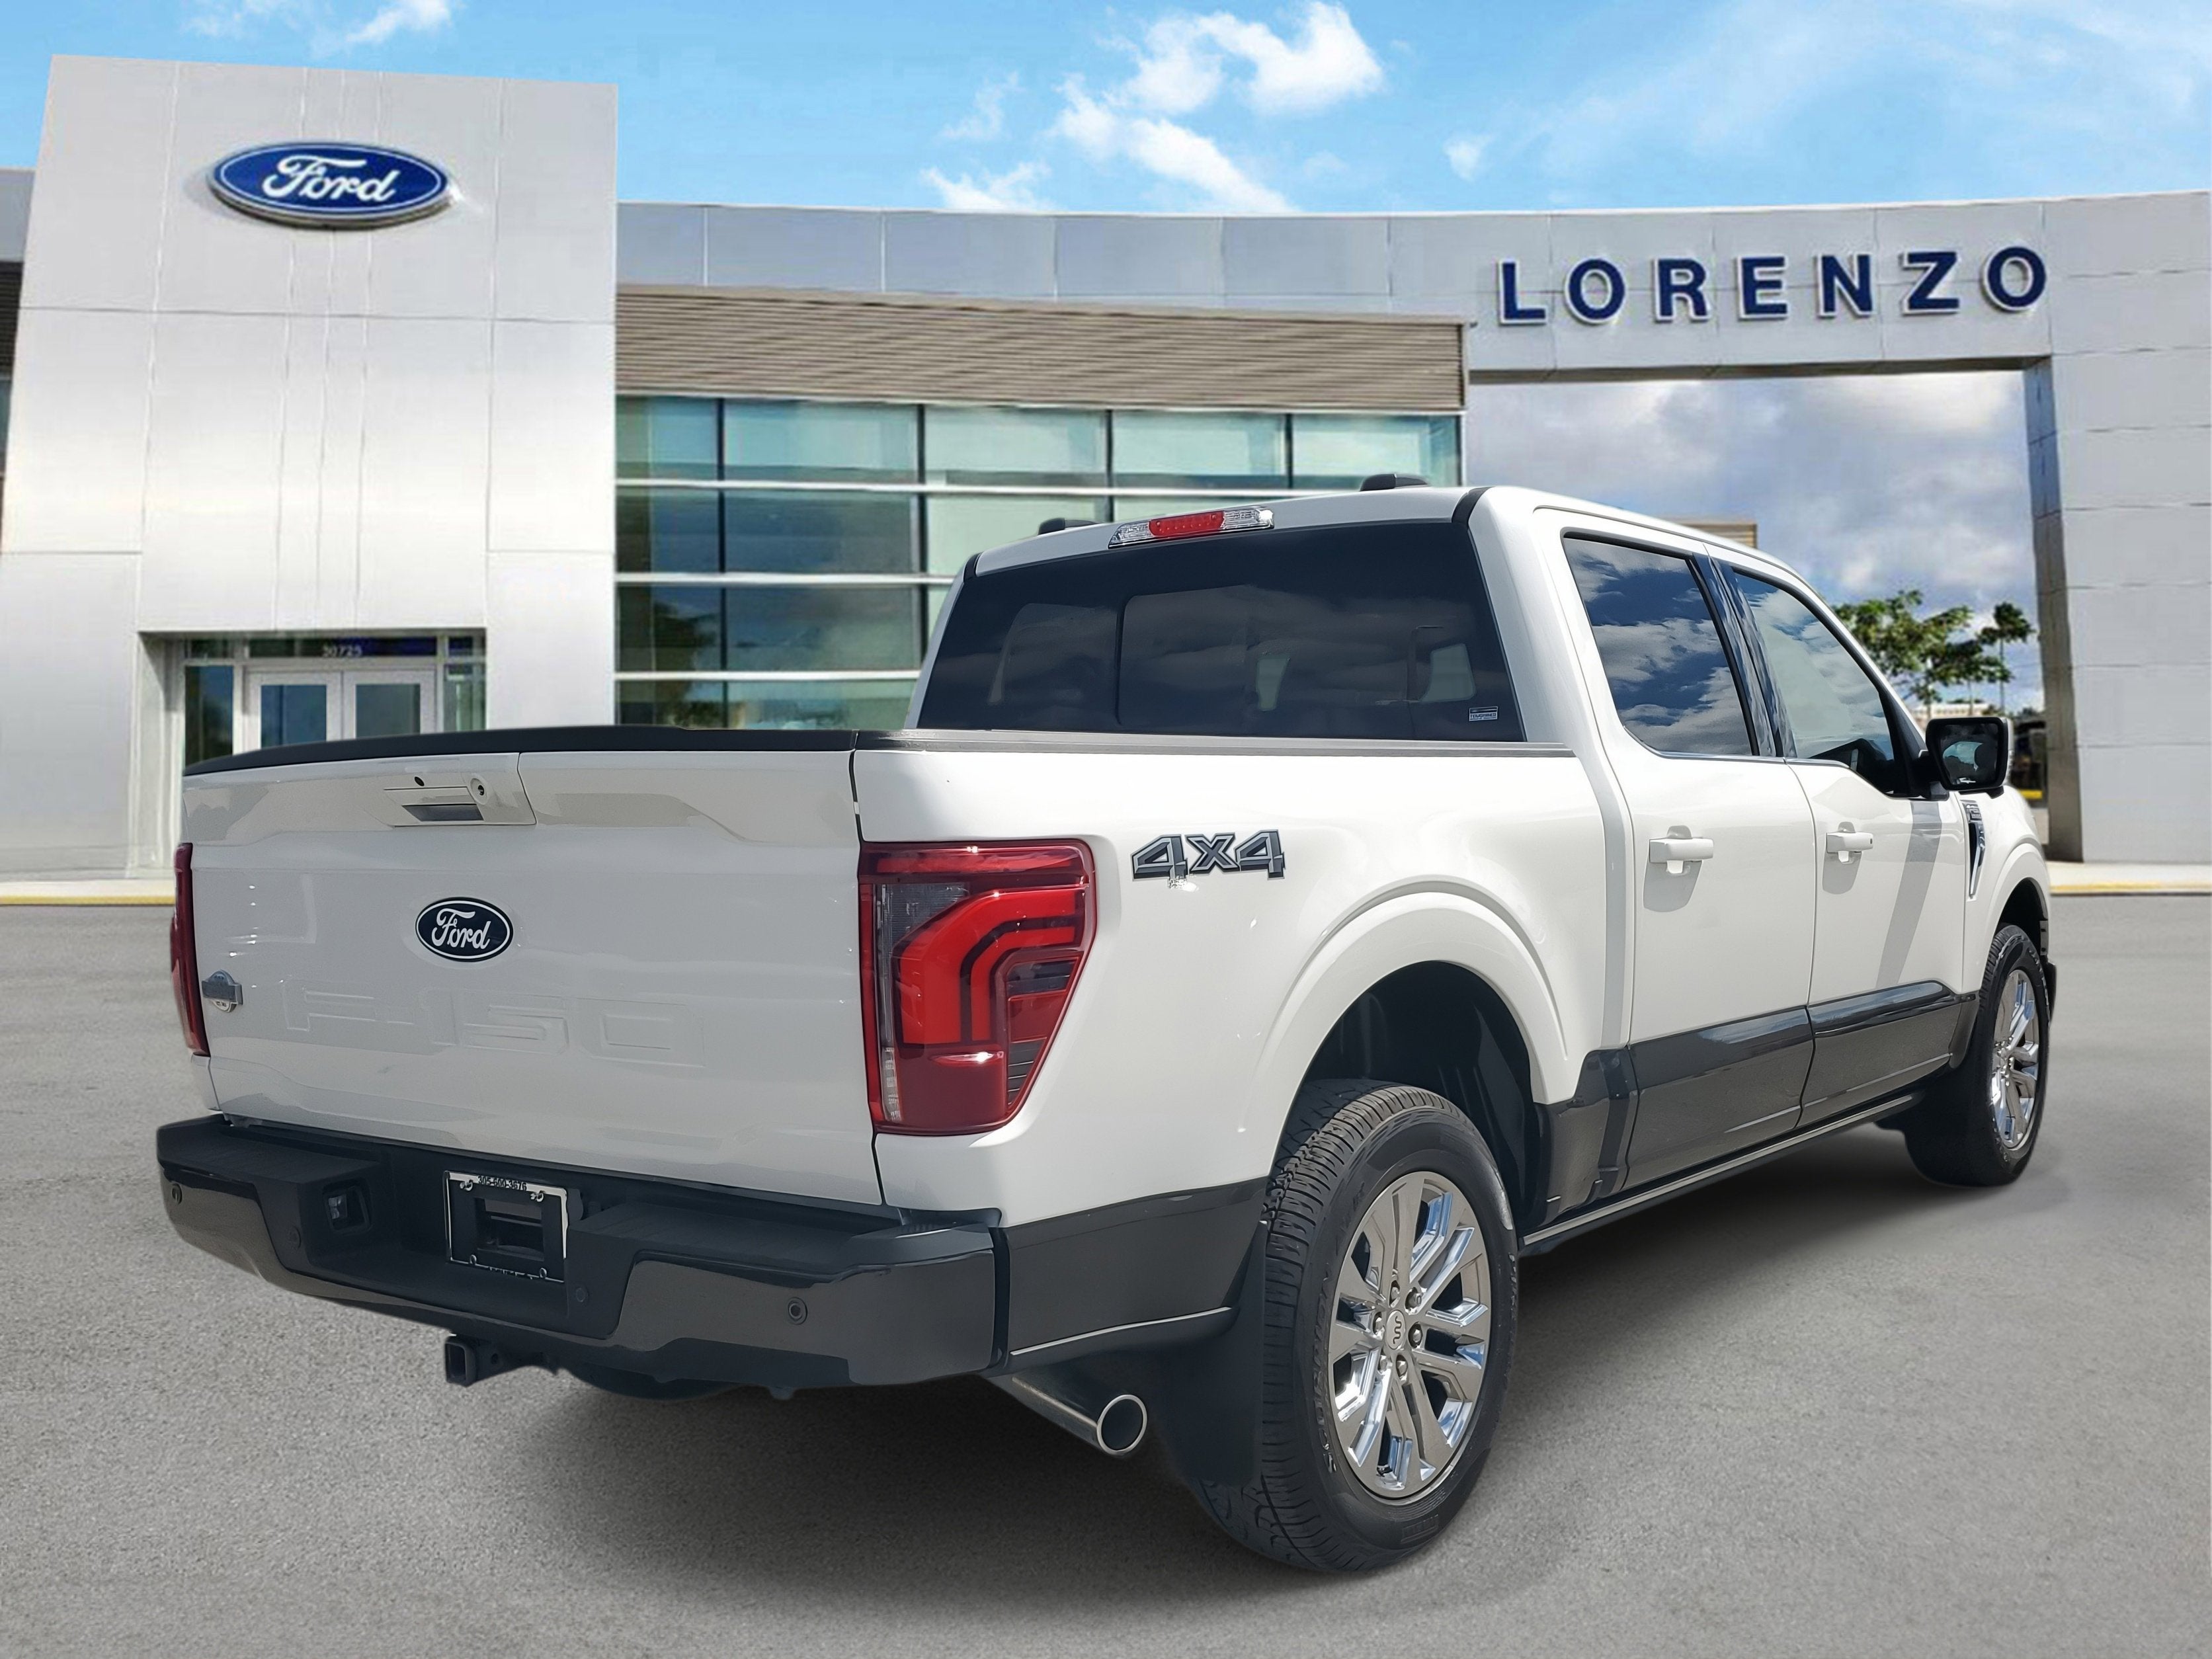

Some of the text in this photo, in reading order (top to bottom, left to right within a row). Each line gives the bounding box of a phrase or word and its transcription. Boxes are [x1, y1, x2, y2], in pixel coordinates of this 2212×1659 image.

[263, 153, 400, 202] Ford
[1498, 246, 2047, 322] LORENZO
[1130, 829, 1286, 882] 4X4
[431, 908, 491, 950] Ford
